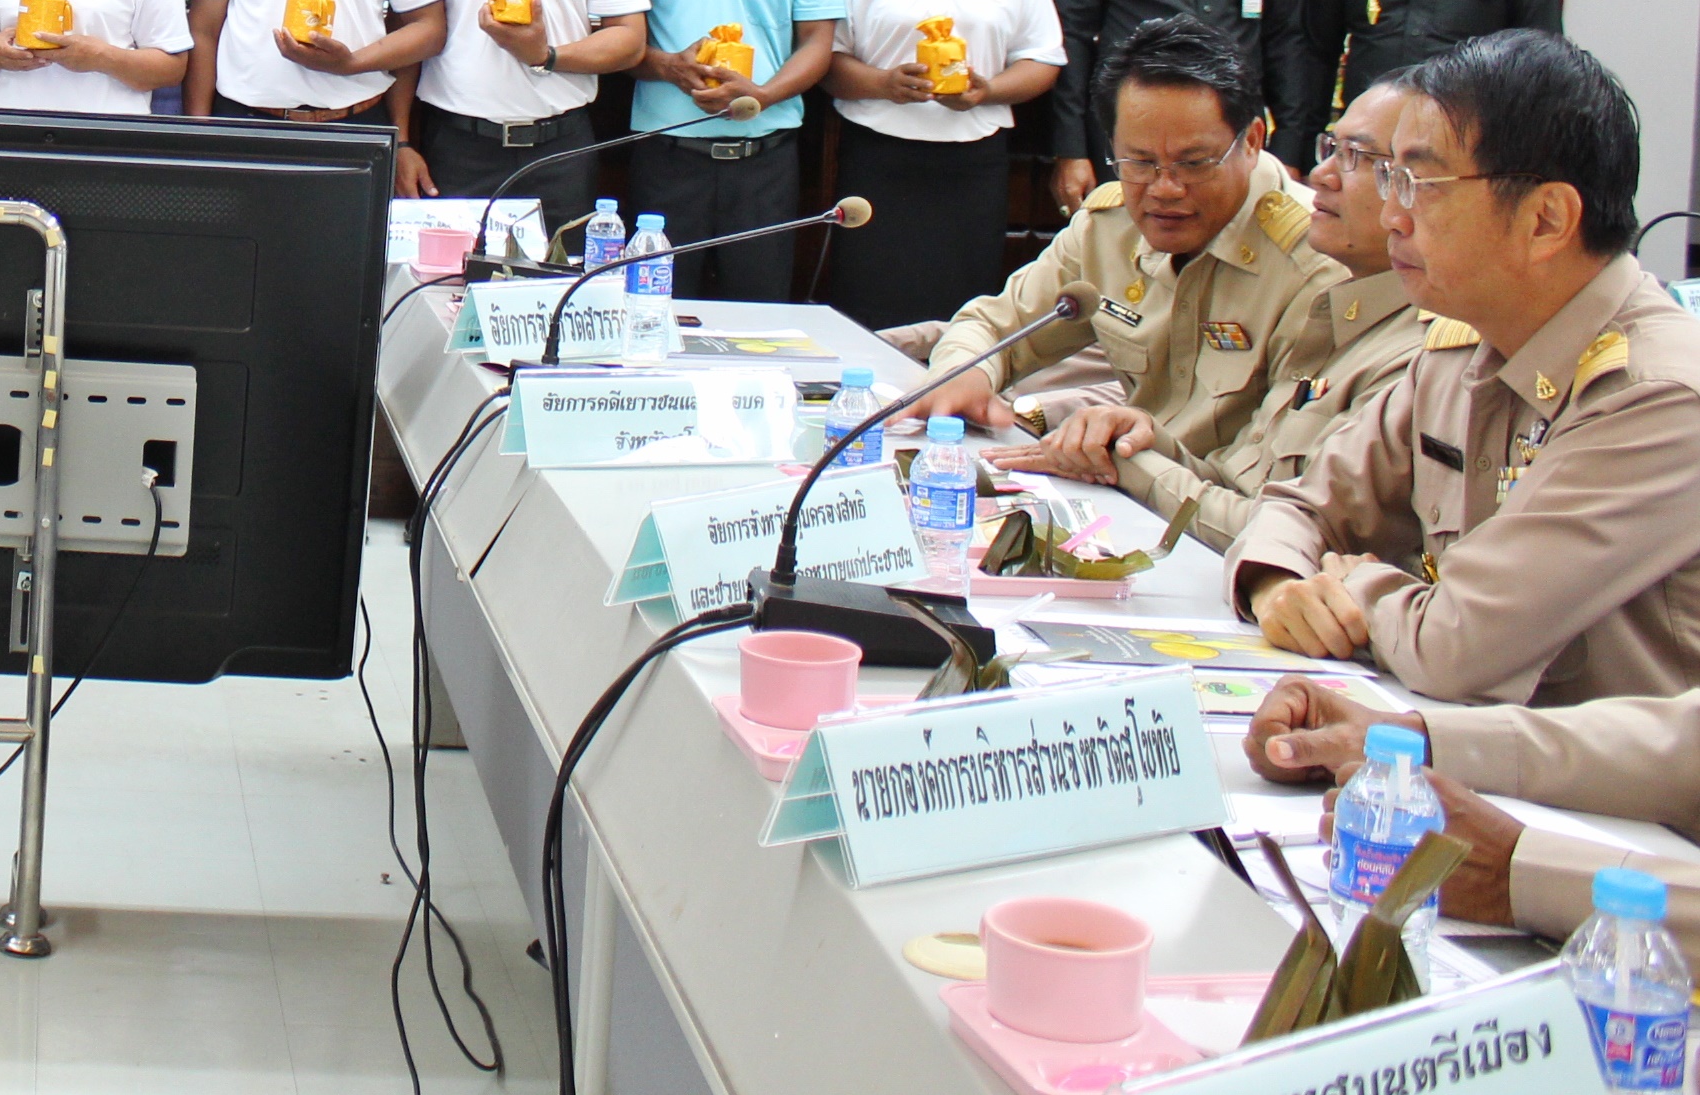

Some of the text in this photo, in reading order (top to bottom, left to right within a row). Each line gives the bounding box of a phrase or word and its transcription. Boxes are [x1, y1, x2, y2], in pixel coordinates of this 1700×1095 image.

[851, 696, 1181, 823] นายกองค์การบริหารส่วนจังหวัดสุโขทัย
